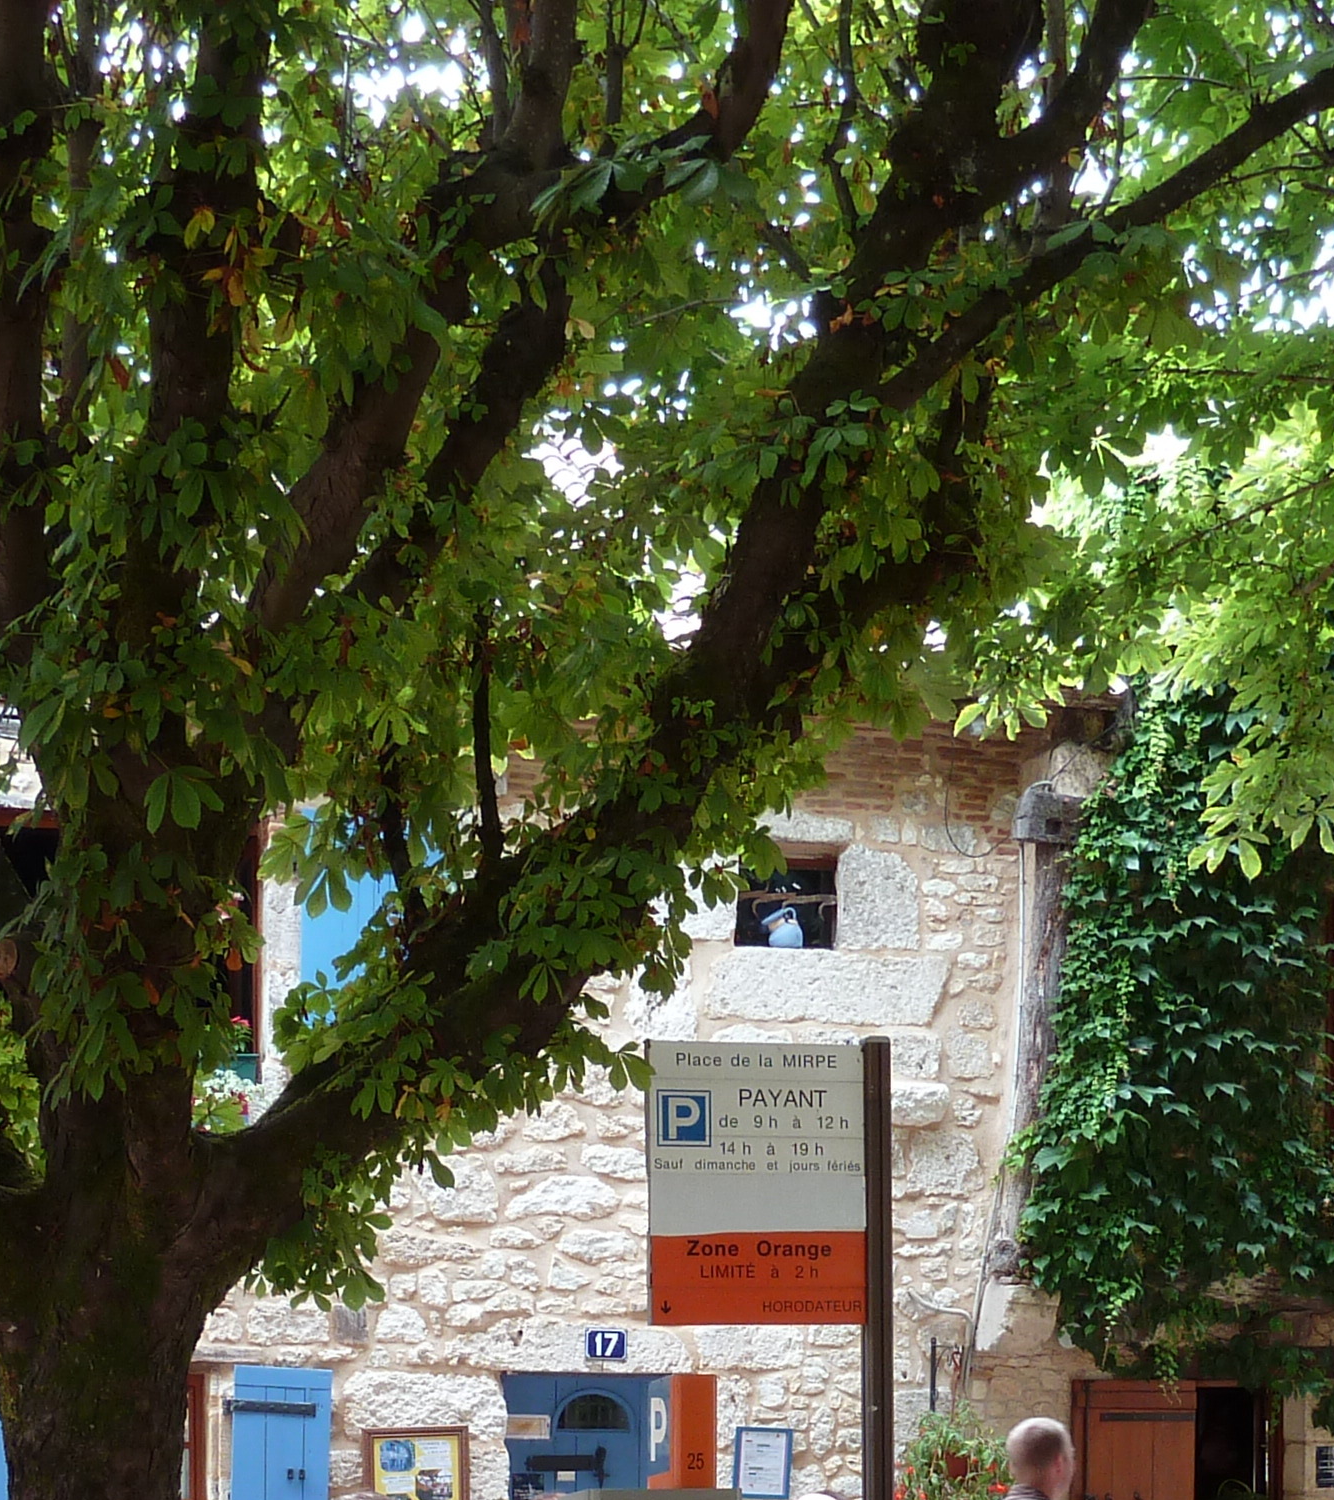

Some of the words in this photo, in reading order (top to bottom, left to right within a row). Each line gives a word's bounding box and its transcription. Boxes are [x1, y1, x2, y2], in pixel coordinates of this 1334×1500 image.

[676, 1053, 722, 1067] Place
[731, 1054, 750, 1067] de
[759, 1054, 773, 1068] la
[783, 1054, 837, 1069] MIRPE
[739, 1089, 827, 1108] PAYANT
[668, 1097, 700, 1139] P
[719, 1115, 739, 1128] de
[792, 1115, 802, 1129] à
[766, 1142, 776, 1156] à
[654, 1158, 683, 1170] Sauf
[694, 1159, 756, 1171] dimanche
[767, 1160, 778, 1171] et
[789, 1160, 820, 1173] jours
[827, 1160, 861, 1172] fériés
[687, 1240, 739, 1257] Zone
[756, 1240, 832, 1260] Orange
[700, 1262, 756, 1279] LIMITÉ
[771, 1265, 779, 1279] à
[762, 1301, 863, 1313] HORODATEUR
[595, 1332, 619, 1357] 17
[650, 1397, 667, 1462] P
[687, 1452, 705, 1470] 25
